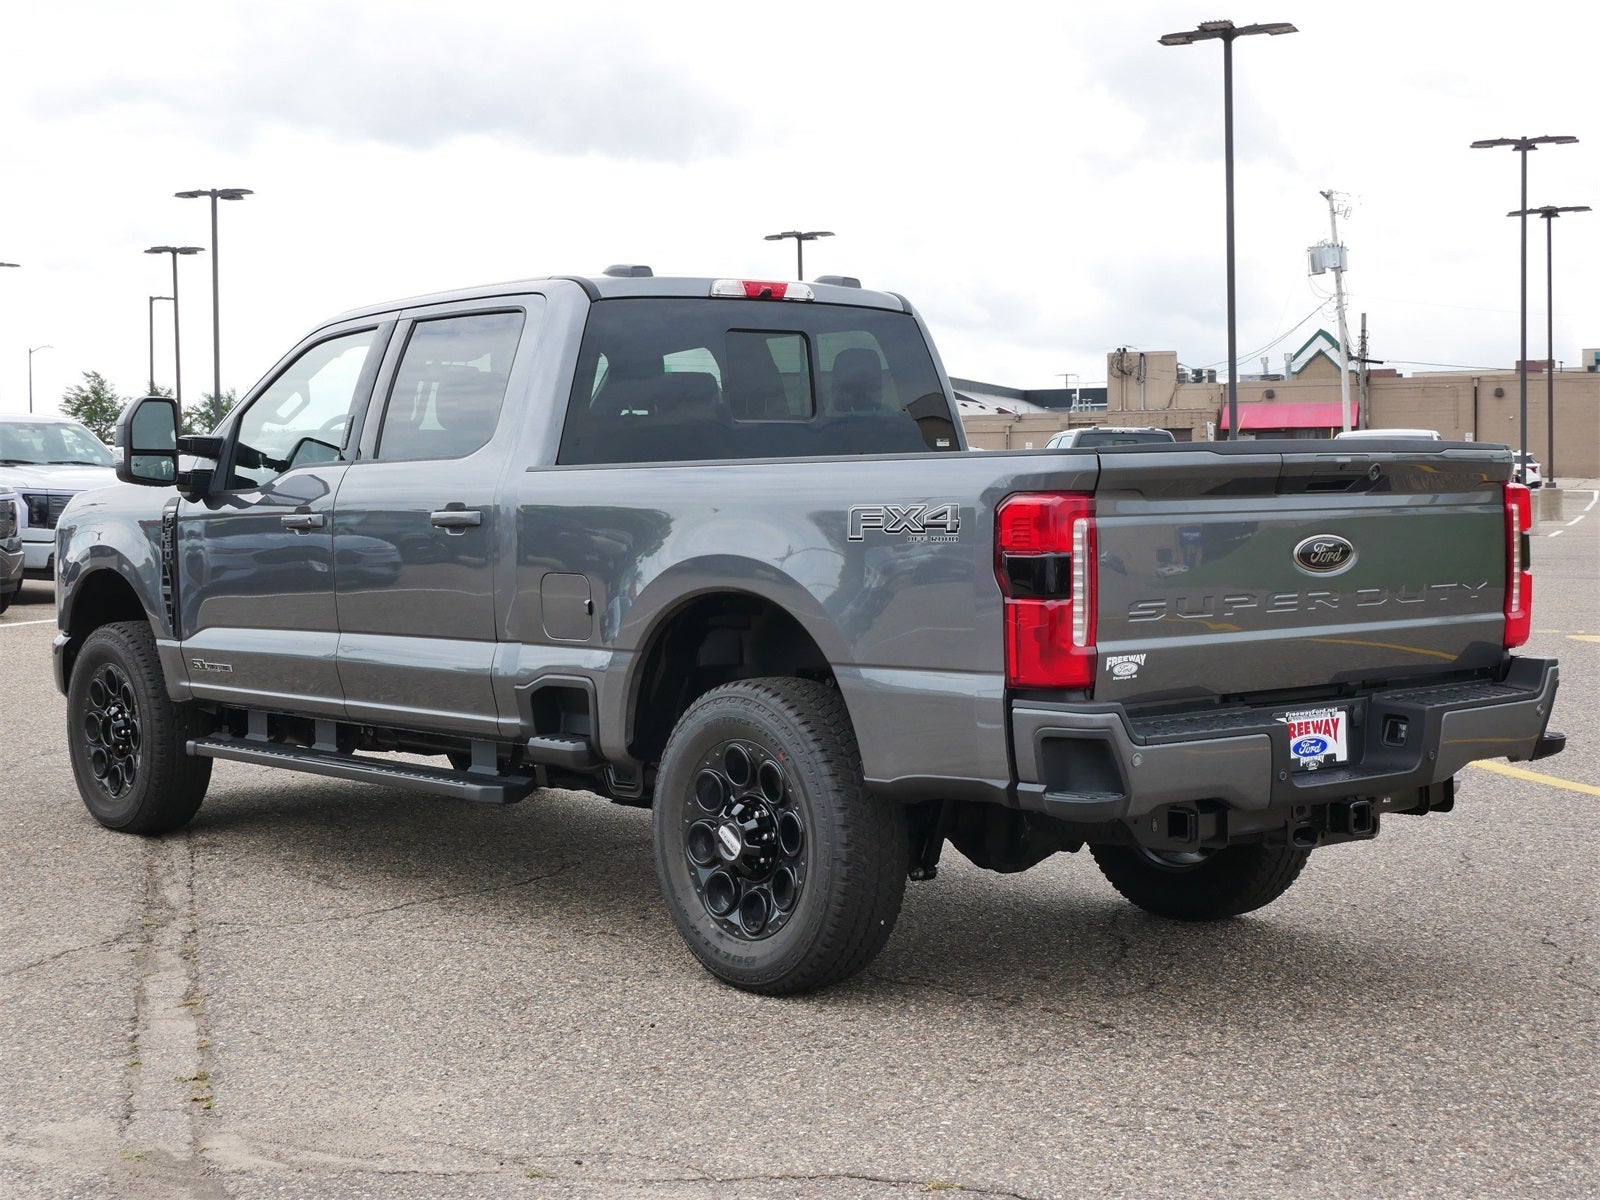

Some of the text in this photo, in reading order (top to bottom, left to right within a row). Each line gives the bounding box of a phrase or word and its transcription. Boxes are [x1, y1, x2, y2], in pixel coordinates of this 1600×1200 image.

[847, 503, 960, 541] FX4
[1310, 542, 1343, 563] Ford
[1128, 580, 1488, 622] SUPER DUTY
[1106, 654, 1146, 671] FREEWAY
[1288, 718, 1340, 743] REEWAY
[1299, 740, 1322, 754] Ford
